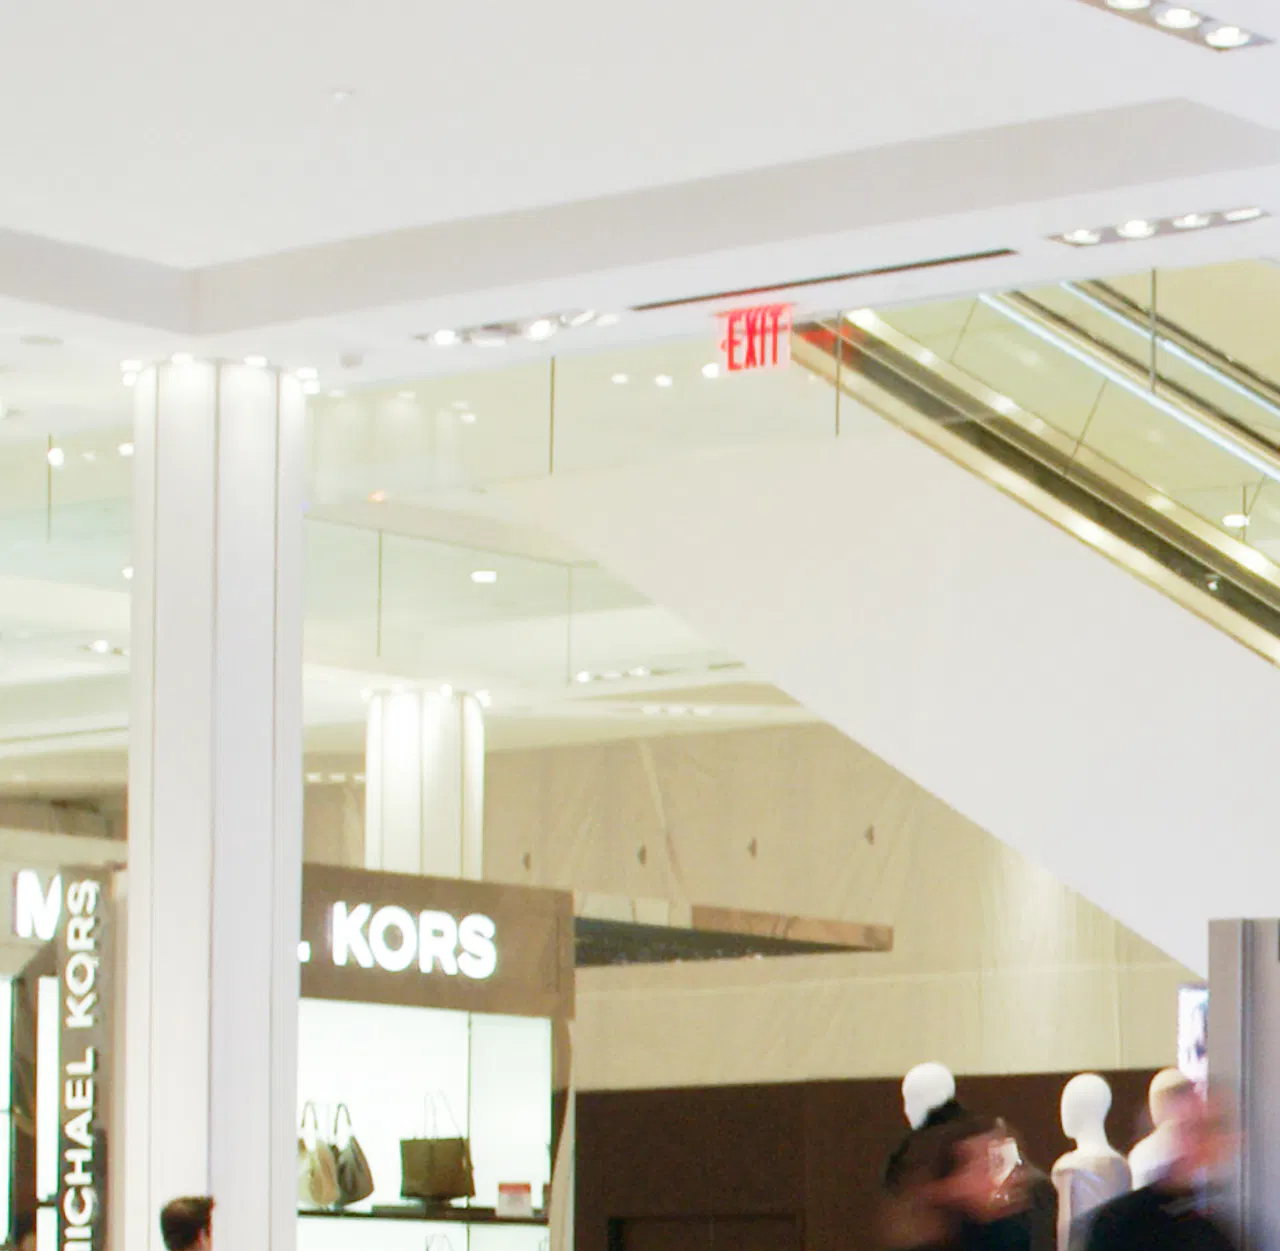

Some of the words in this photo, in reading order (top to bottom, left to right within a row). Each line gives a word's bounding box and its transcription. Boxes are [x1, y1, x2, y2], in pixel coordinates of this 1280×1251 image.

[727, 306, 782, 370] EXIT
[67, 879, 99, 1030] KORS
[332, 900, 497, 979] KORS
